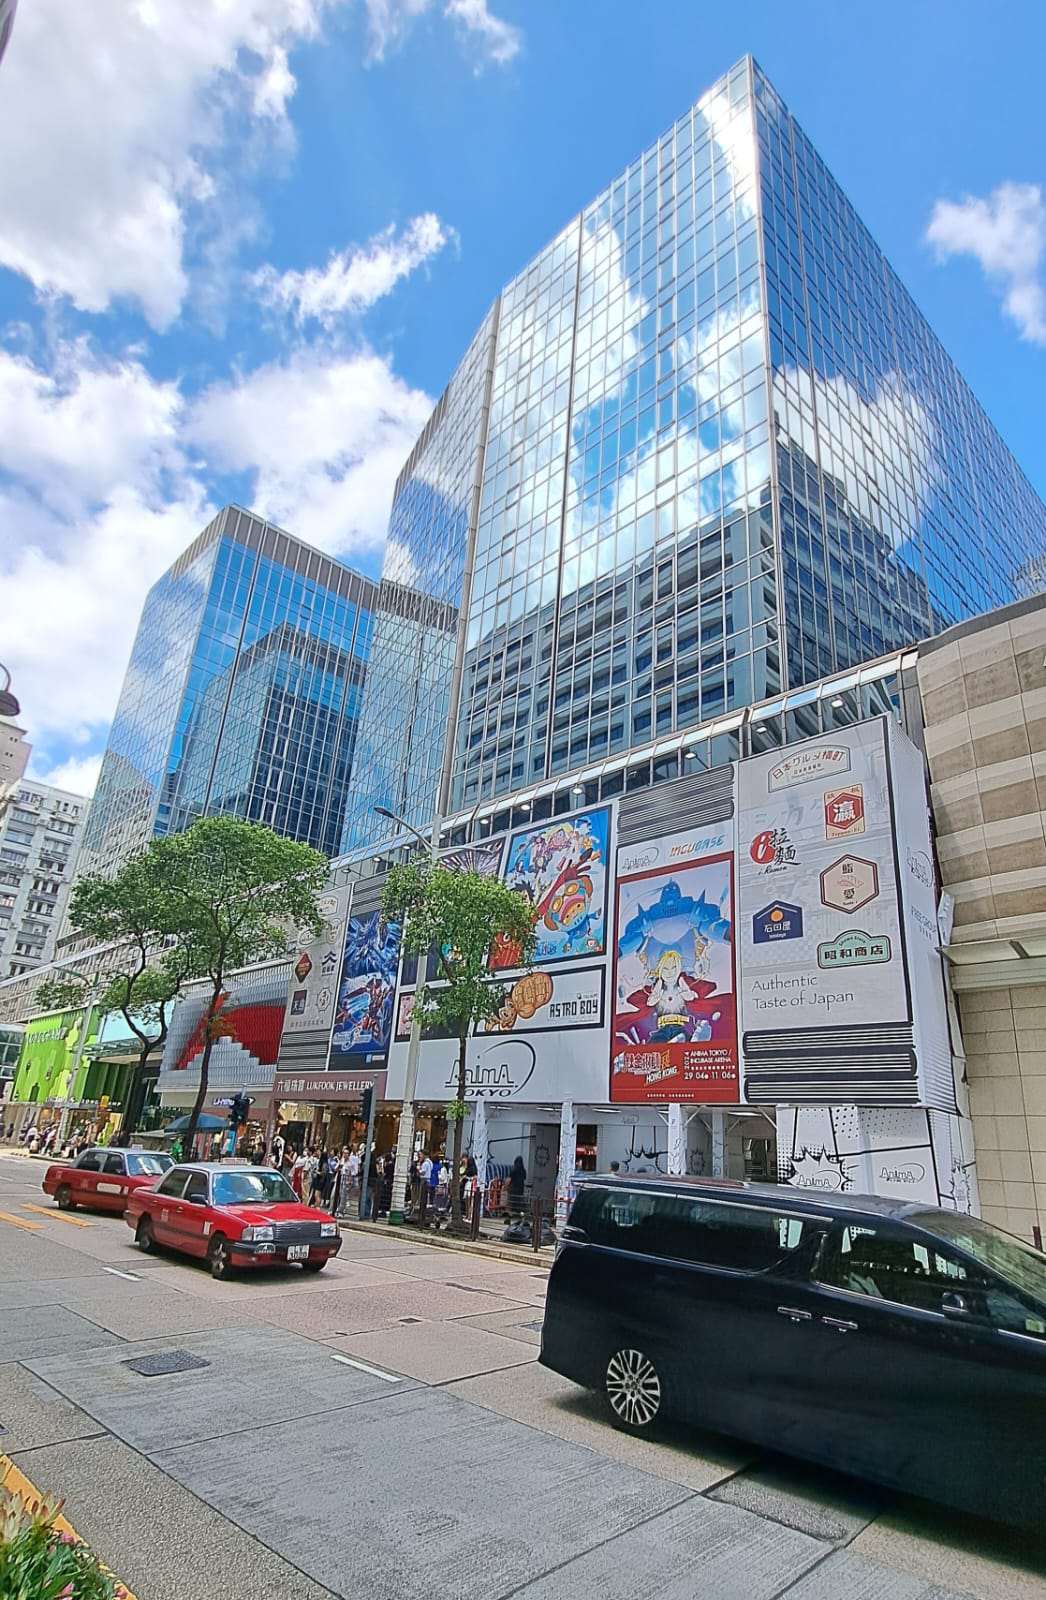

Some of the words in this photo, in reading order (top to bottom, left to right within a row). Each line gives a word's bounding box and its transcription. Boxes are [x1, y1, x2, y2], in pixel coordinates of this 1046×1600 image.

[824, 944, 884, 960] 昭和商店
[752, 973, 819, 992] Authentic
[550, 1001, 577, 1018] ASTRO
[580, 999, 598, 1015] BOY
[752, 996, 787, 1009] Taste
[790, 990, 806, 1006] of
[808, 992, 854, 1011] Japan
[684, 1071, 694, 1080] 29
[335, 1080, 375, 1093] JEWELLERY
